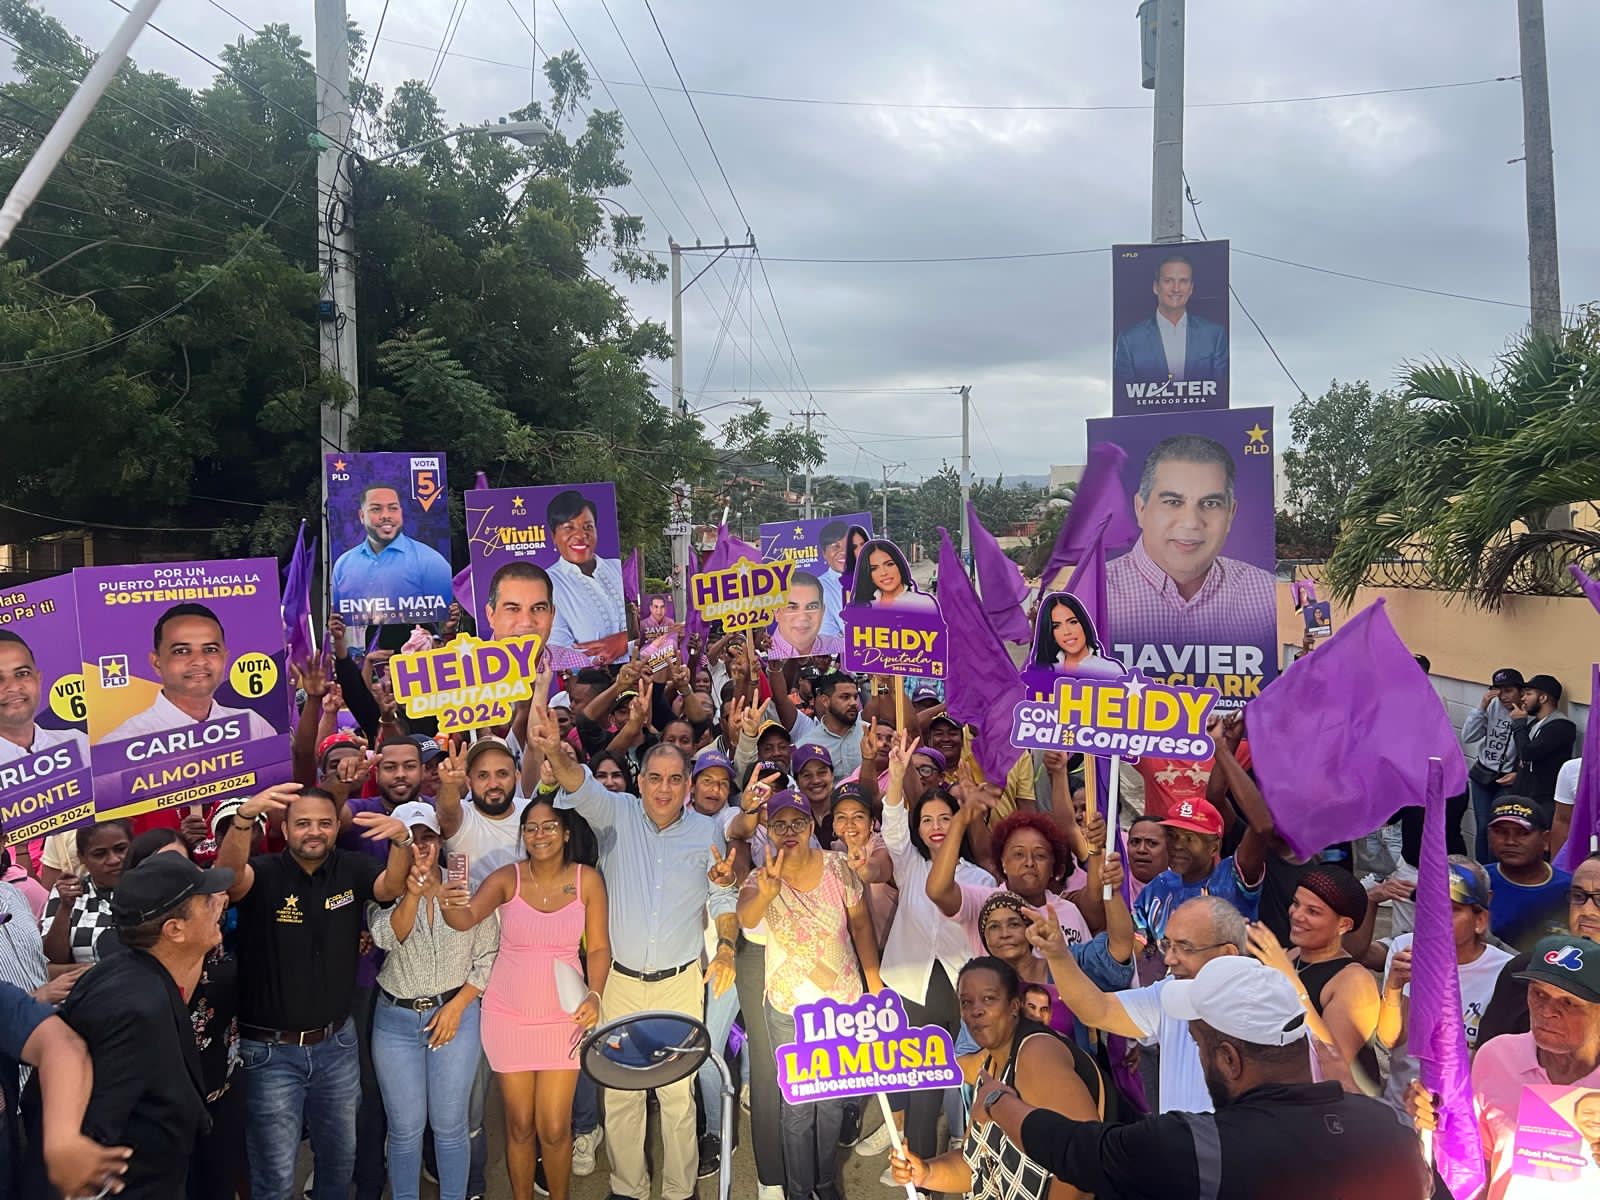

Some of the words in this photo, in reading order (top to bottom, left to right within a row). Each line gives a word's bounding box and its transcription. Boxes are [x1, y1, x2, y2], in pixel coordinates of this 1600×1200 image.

[1126, 380, 1216, 398] WALTER
[1244, 444, 1270, 456] PLD
[418, 472, 435, 495] 5
[506, 542, 546, 551] REGIDORA
[100, 580, 154, 592] PUERTO
[159, 577, 199, 588] PLATA
[203, 575, 242, 586] HACIA
[244, 574, 260, 583] LA
[154, 568, 182, 578] POR
[186, 568, 205, 577] UN
[104, 584, 257, 606] SOSTENIBILIDAD
[696, 564, 792, 606] HEIDY
[0, 592, 26, 608] lata
[40, 600, 55, 614] ti!
[339, 598, 395, 613] ENYEL
[398, 595, 446, 610] MATA
[706, 593, 784, 616] DIPUTADA
[726, 609, 769, 628] 2024
[645, 626, 668, 634] JAVIE
[853, 626, 938, 652] HEIDY
[238, 660, 271, 673] VOTA
[396, 640, 536, 698] HEIDY
[862, 648, 932, 668] Diputada
[1114, 644, 1264, 675] JAVIER
[56, 680, 85, 698] VOT
[103, 676, 127, 687] PLD
[248, 673, 263, 695] 6
[70, 695, 87, 719] 6
[412, 680, 526, 713] DIPUTADA
[443, 701, 506, 728] 2024
[1019, 707, 1059, 724] CON
[1059, 684, 1214, 735] HEIDY
[126, 720, 241, 761] CARLOS
[1076, 726, 1209, 756] Congreso
[1490, 728, 1508, 740] JUS
[0, 748, 72, 791] RLOS
[131, 750, 244, 794] ALMONTE
[0, 779, 81, 824] MONTE
[156, 784, 217, 808] REGIDOR
[220, 776, 250, 790] 2024
[62, 806, 91, 824] 2024
[802, 998, 899, 1043] Llegó
[784, 1048, 832, 1084] LA
[836, 1035, 947, 1076] MUSA
